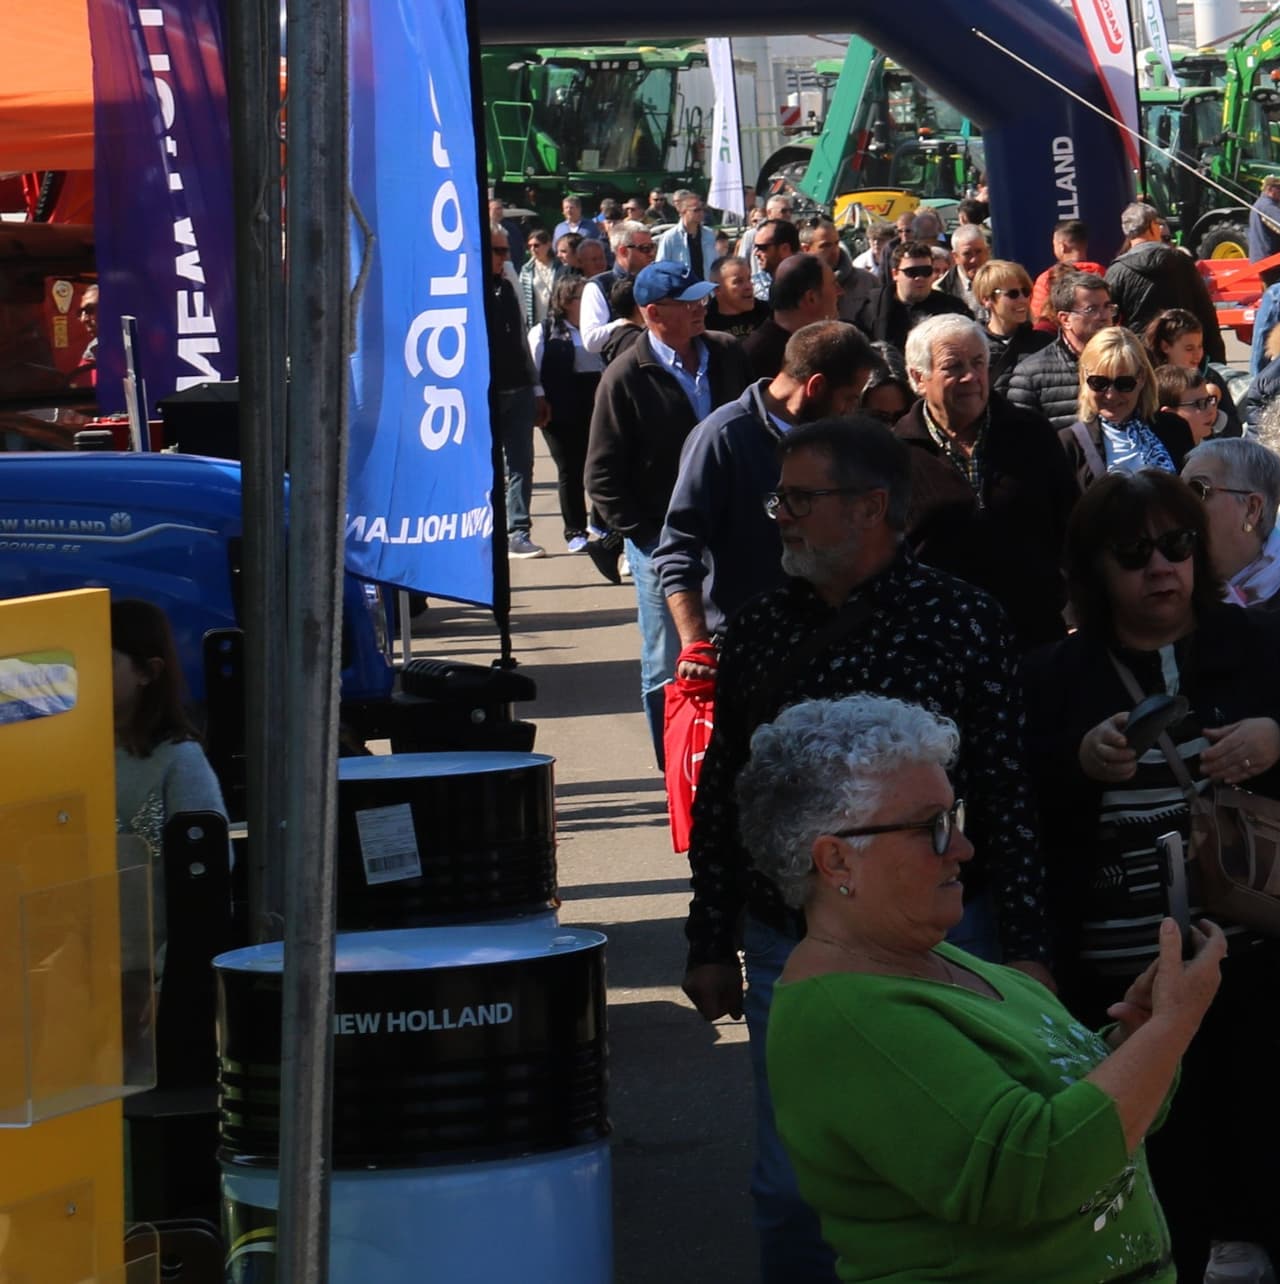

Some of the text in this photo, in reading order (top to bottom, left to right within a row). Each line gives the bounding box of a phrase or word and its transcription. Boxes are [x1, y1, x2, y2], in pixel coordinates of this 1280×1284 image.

[1052, 136, 1080, 220] LLAND
[24, 518, 106, 533] HOLLAND
[0, 541, 56, 552] OOMER
[387, 1002, 513, 1033] HOLLAND
